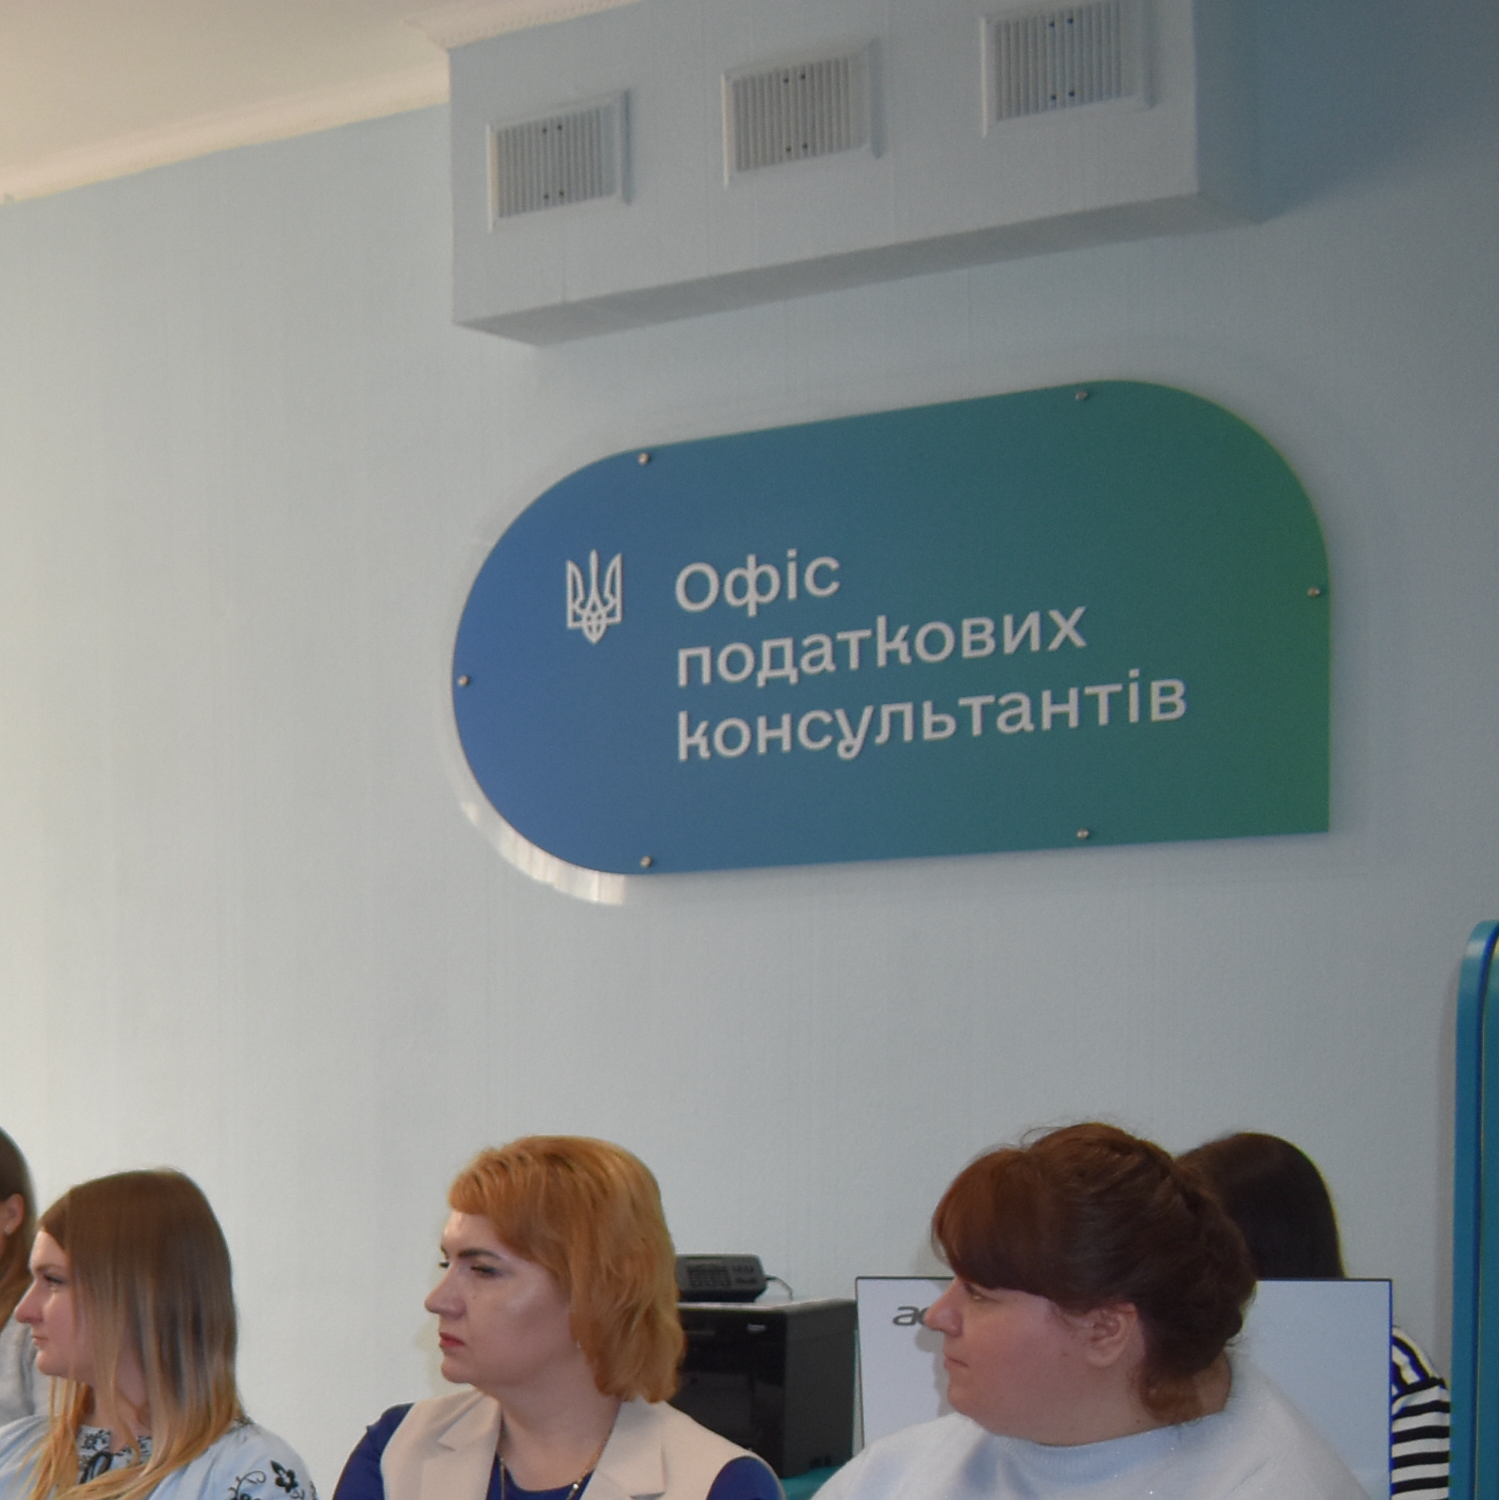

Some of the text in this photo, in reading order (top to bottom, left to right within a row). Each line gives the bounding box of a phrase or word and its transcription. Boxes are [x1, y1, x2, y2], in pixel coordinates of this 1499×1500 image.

[674, 548, 841, 617] Офіс
[677, 606, 1088, 688] податкових
[677, 668, 1188, 763] консультантів
